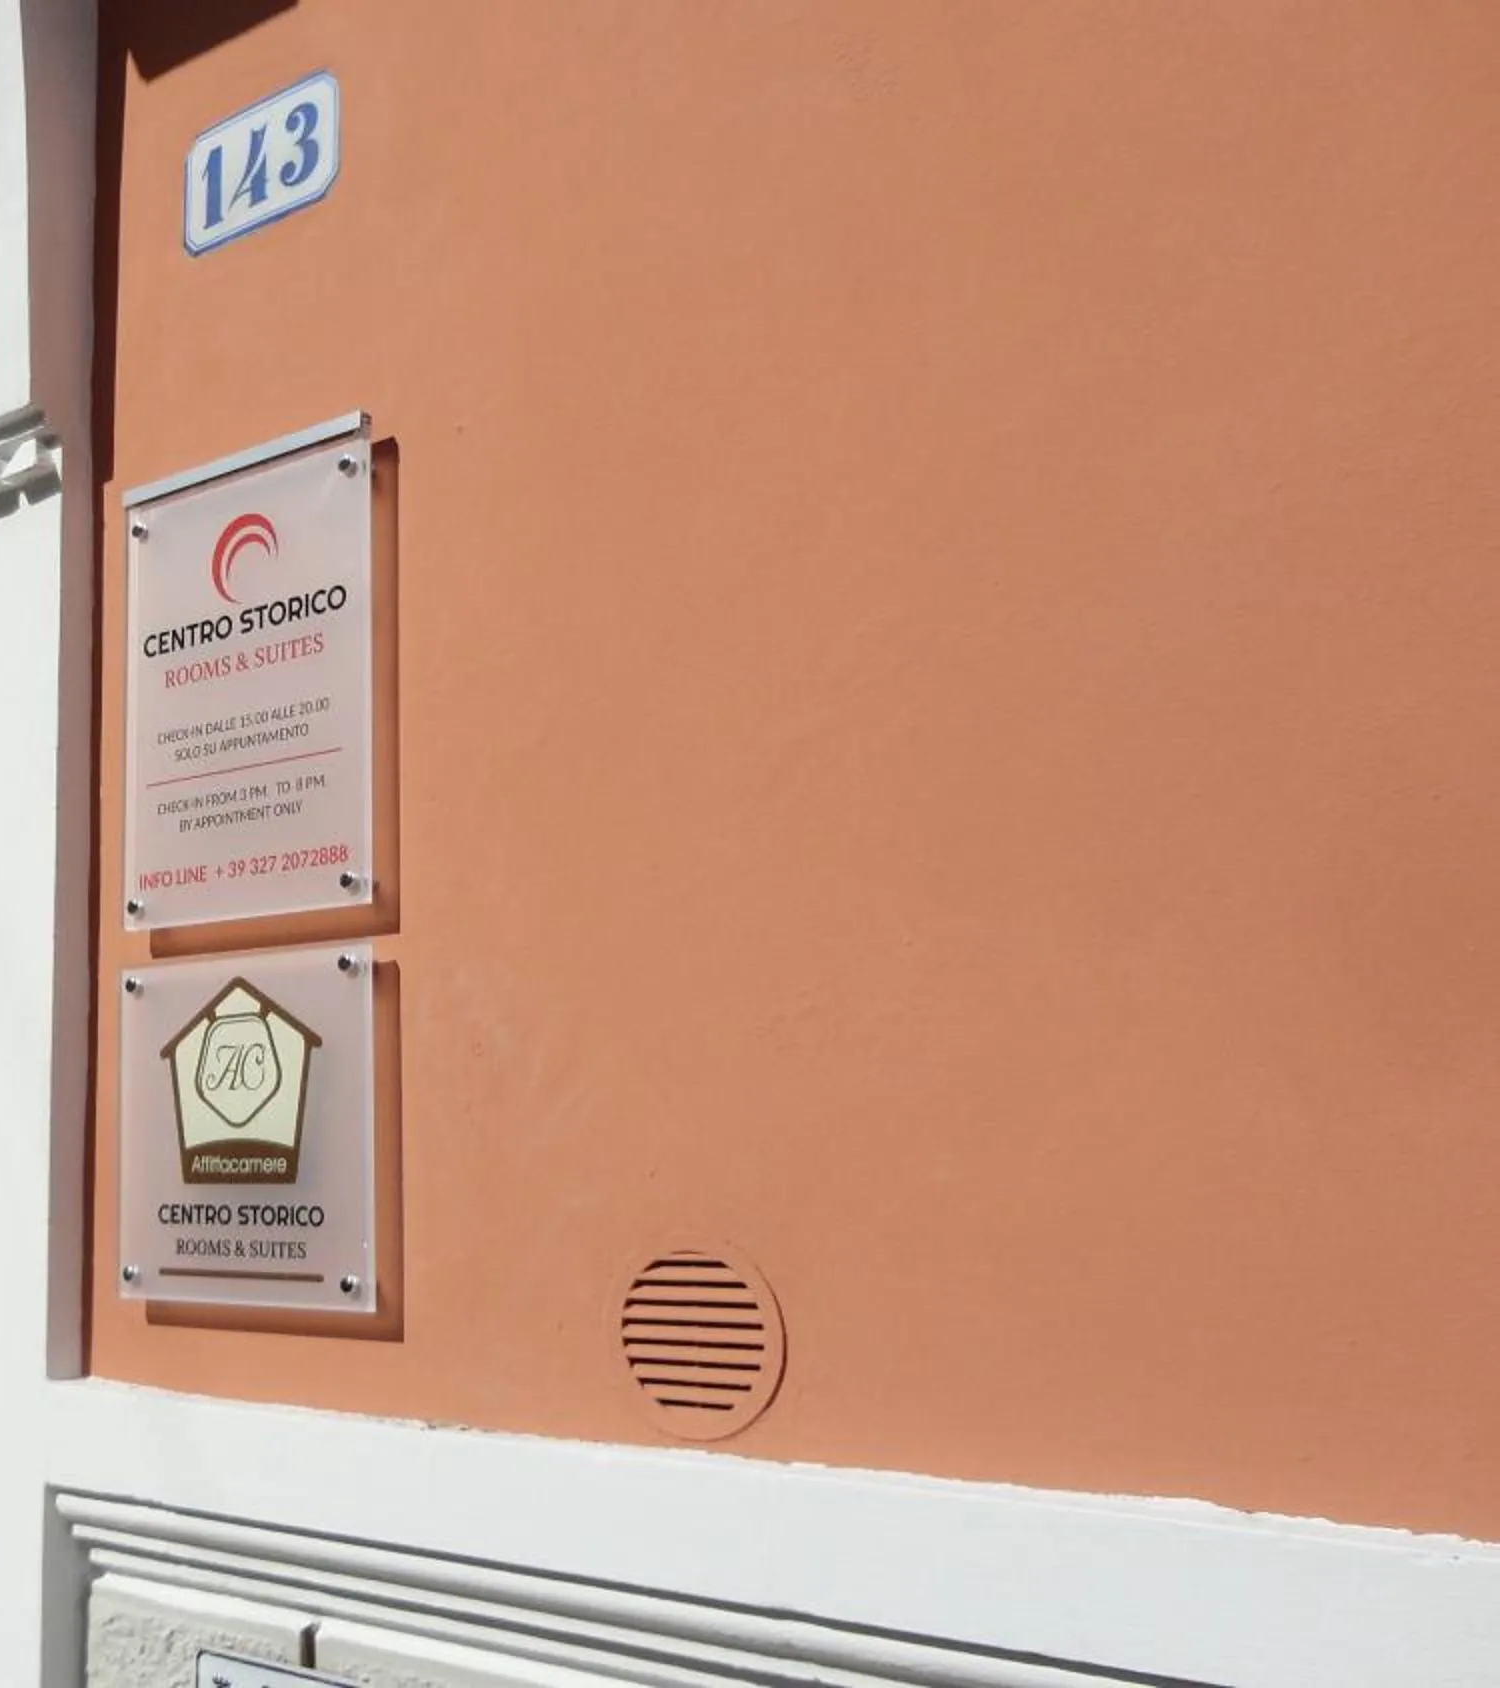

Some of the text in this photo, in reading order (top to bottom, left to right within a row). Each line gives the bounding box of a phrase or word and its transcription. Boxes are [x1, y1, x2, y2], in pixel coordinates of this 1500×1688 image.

[202, 102, 319, 229] 143
[143, 585, 347, 658] CENTRO STORICO
[164, 632, 325, 688] ROOMS & SUITES
[205, 716, 236, 735] DALLE
[271, 704, 296, 720] ALLE
[174, 723, 309, 762] SOLO SU APPUNTAMENTO
[205, 789, 237, 807] FROM
[240, 788, 247, 801] 3
[276, 781, 291, 796] TO
[179, 799, 303, 833] BY APPOINTMENT ONLY
[139, 872, 172, 891] INFO
[175, 865, 208, 885] LINE
[227, 860, 245, 879] 39
[250, 856, 277, 876] 327
[281, 844, 349, 871] 2072888
[158, 1204, 325, 1228] CENTRO STORICO
[176, 1239, 307, 1260] ROOMS & SUITES
